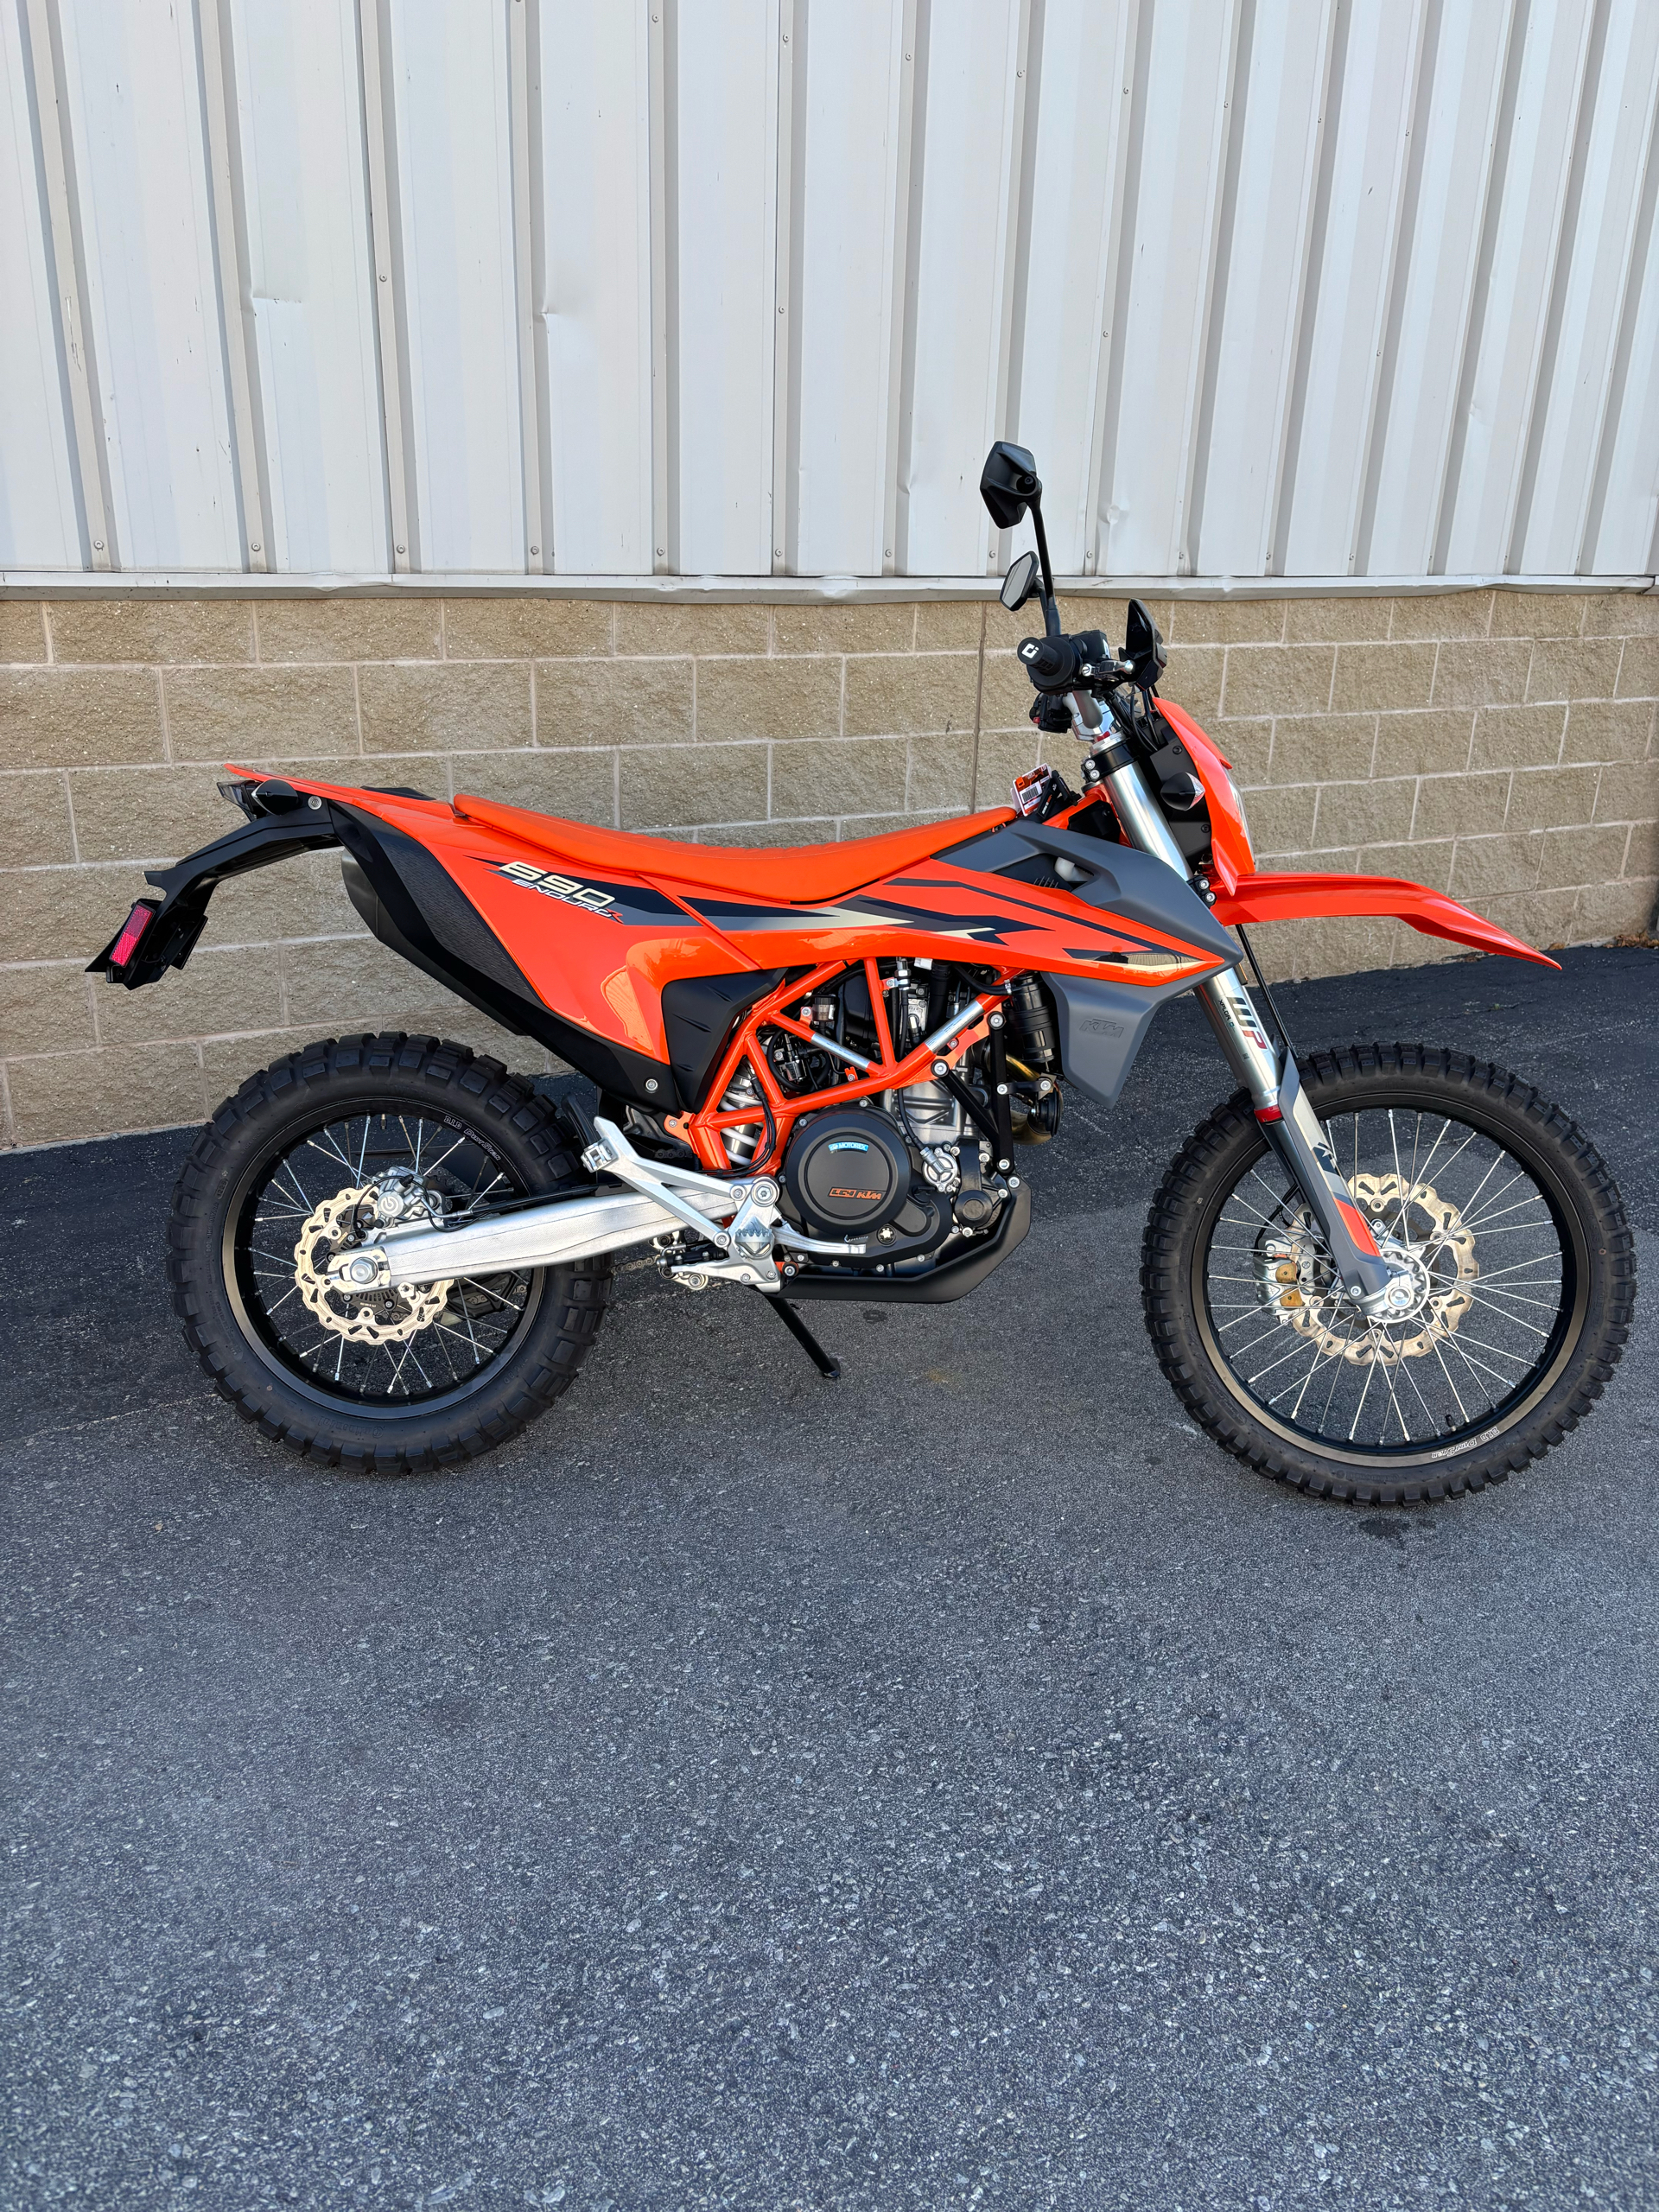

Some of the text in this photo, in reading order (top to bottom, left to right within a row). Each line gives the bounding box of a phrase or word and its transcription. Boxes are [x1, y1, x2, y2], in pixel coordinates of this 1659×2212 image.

[499, 861, 615, 907] 690
[512, 879, 613, 918] ENDURO
[1218, 999, 1232, 1021] XPLOR
[1079, 1018, 1124, 1038] KTM
[838, 1141, 868, 1151] MOTOREX
[856, 1191, 881, 1200] KTM
